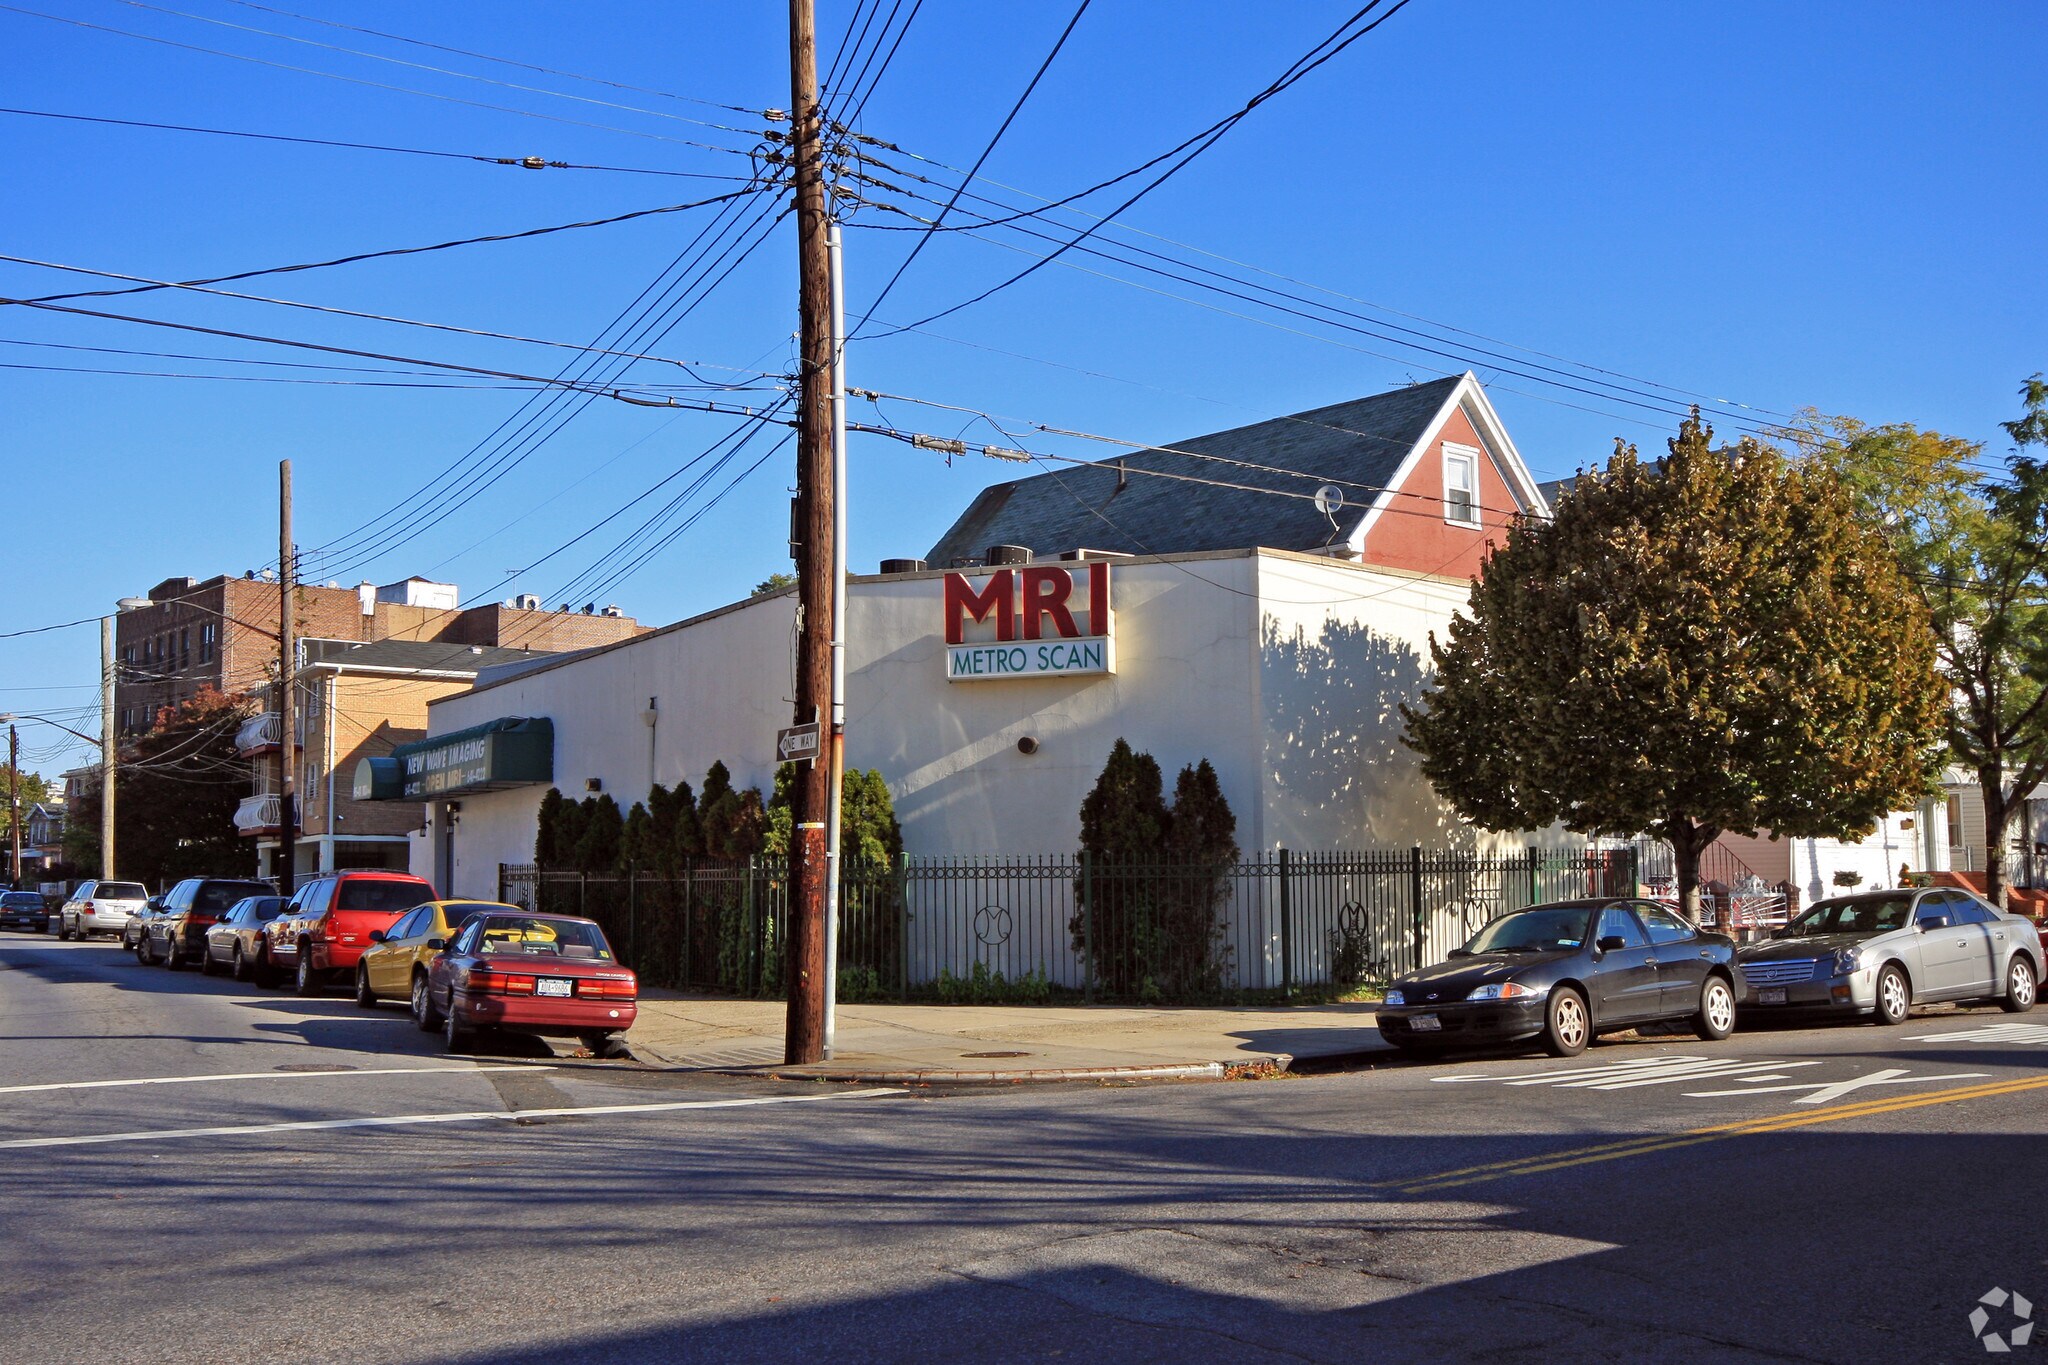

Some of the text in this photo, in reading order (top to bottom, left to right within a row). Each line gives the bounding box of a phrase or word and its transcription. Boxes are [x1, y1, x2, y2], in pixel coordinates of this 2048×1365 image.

[943, 562, 1111, 645] MRI
[953, 643, 1101, 675] METRO SCAN
[407, 740, 485, 775] NEW WAVE IMAGING
[783, 734, 814, 751] ONE WAY
[425, 773, 445, 792] OPEN
